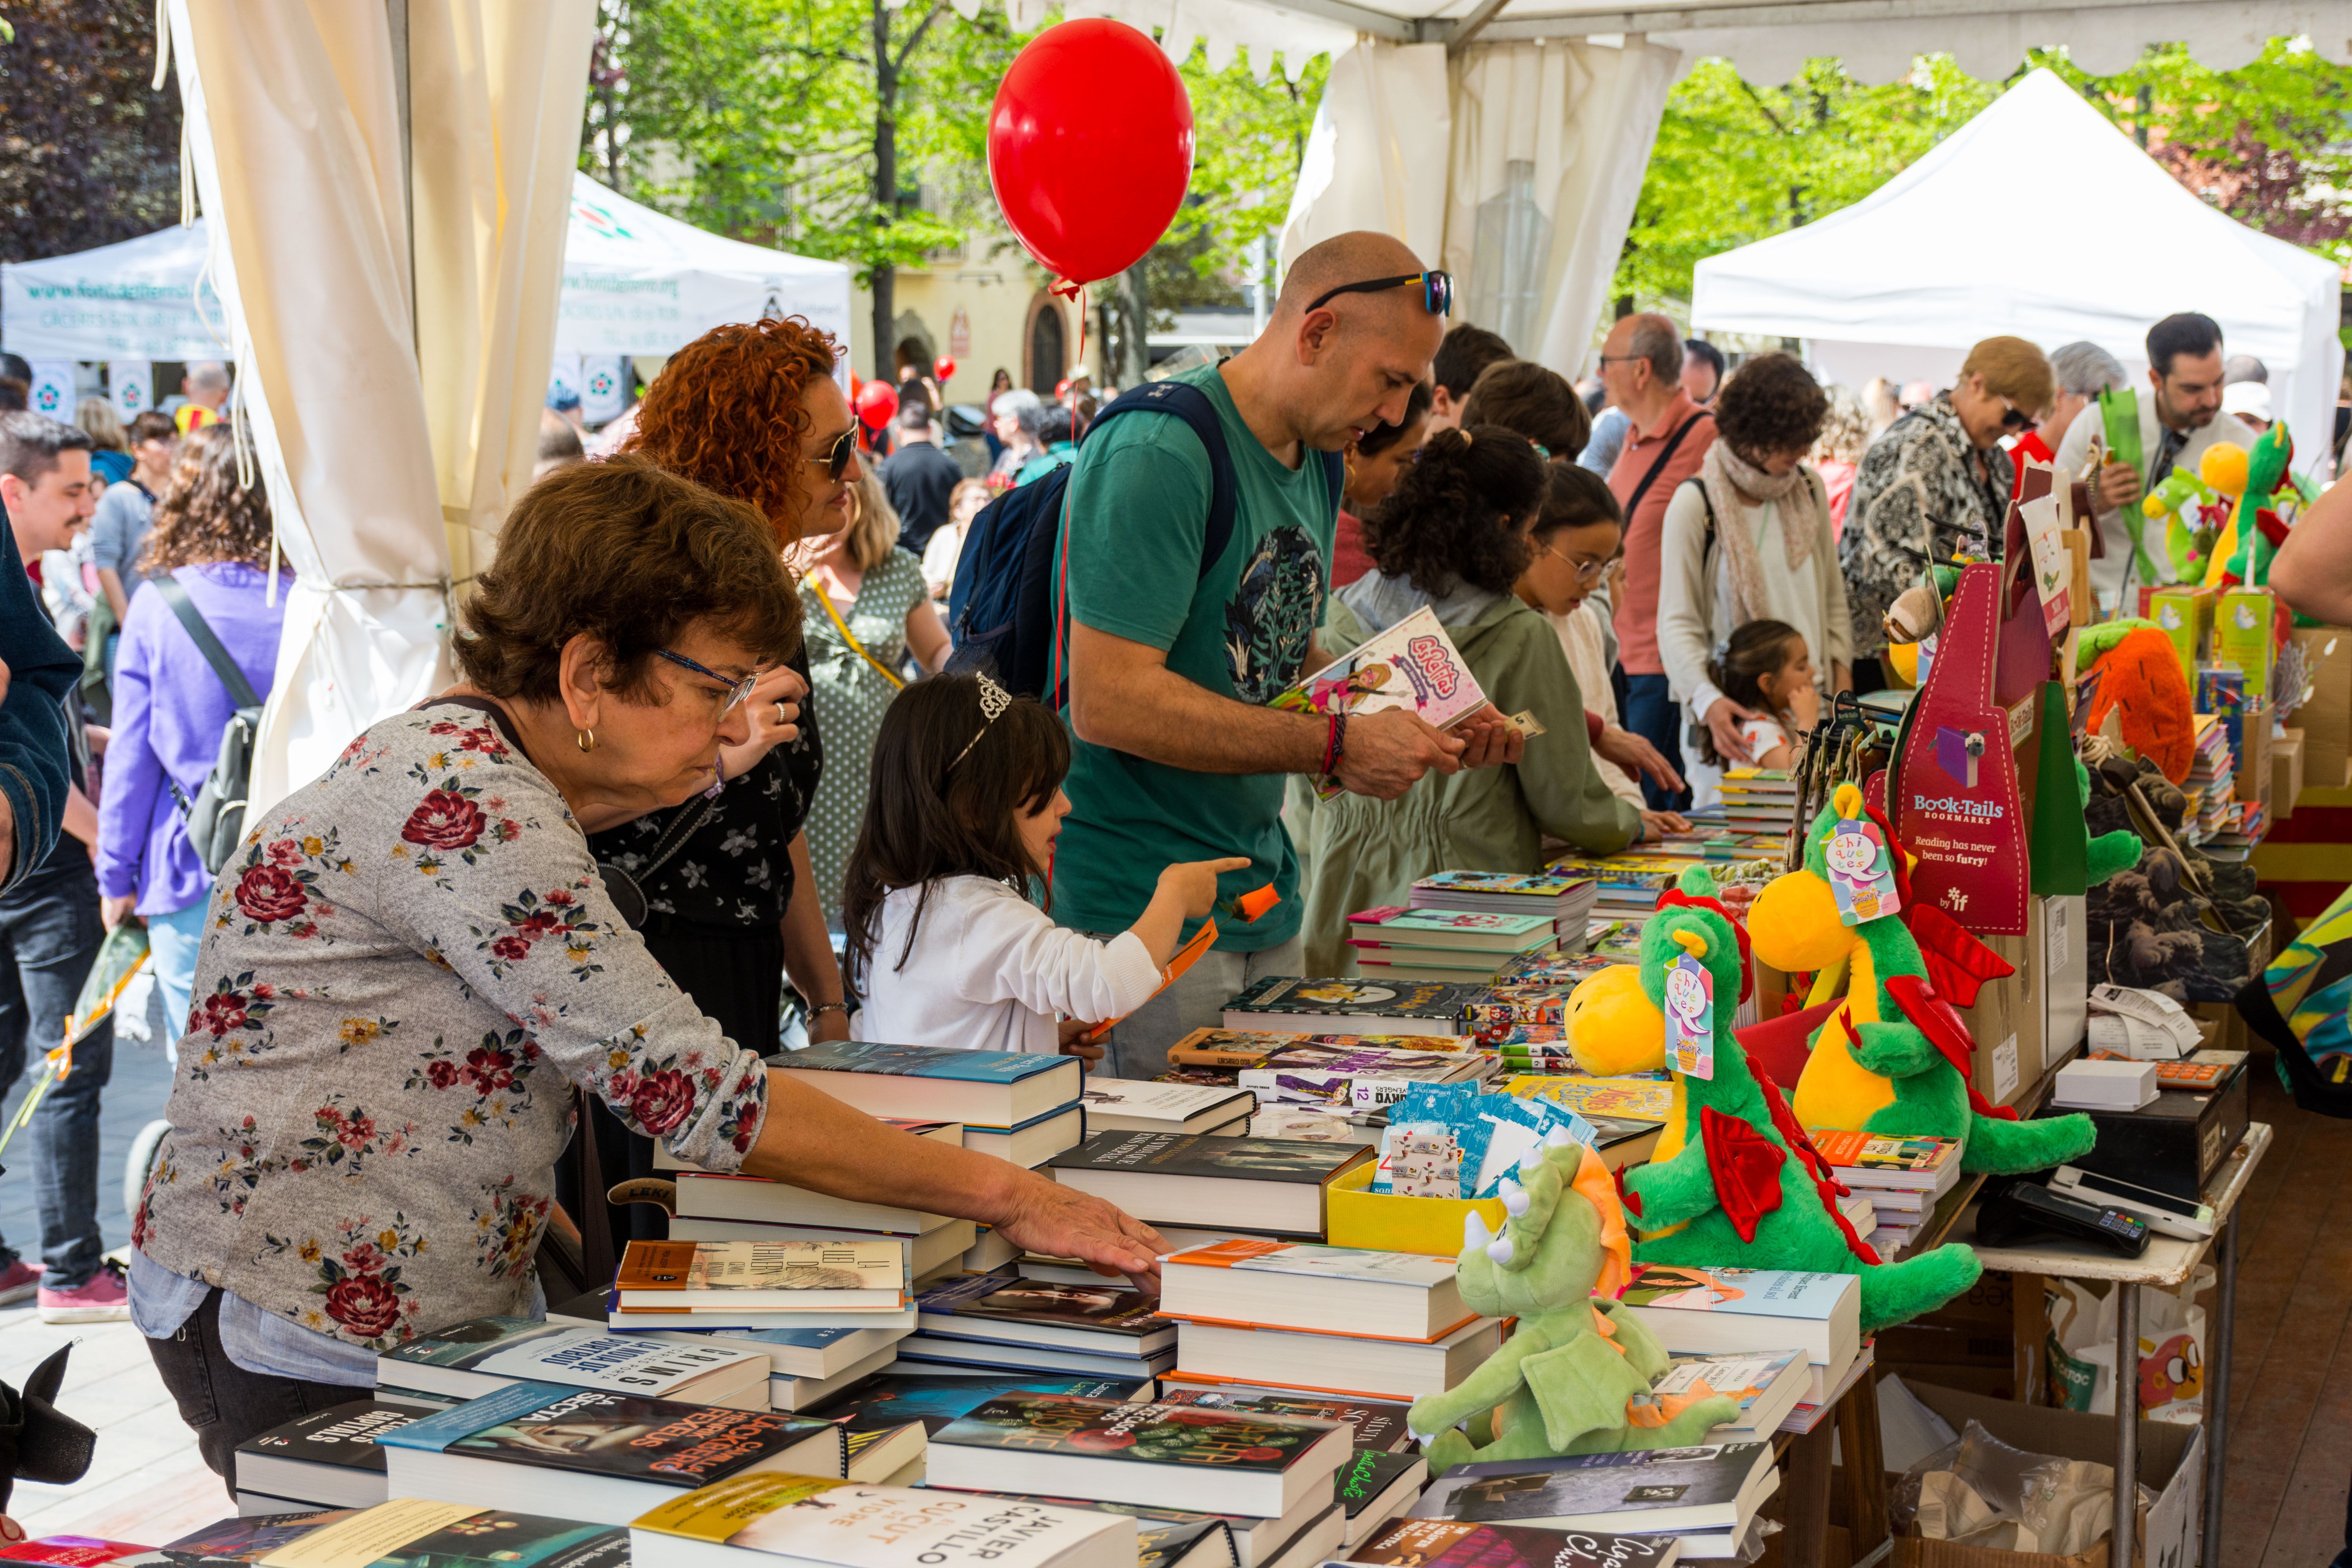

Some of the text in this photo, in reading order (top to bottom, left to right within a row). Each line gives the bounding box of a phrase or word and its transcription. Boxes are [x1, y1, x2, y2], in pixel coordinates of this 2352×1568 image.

[1412, 639, 1456, 694] Las Ratitas
[1515, 716, 1524, 725] 5
[1914, 795, 2004, 818] Book-Tails
[1924, 812, 1991, 825] BOOKMARKS
[1915, 836, 1996, 853] Reading has never
[1922, 850, 1987, 867] been so furry!
[1940, 897, 1950, 908] by
[1490, 1008, 1501, 1018] 19
[1357, 1087, 1368, 1101] 12
[1127, 1132, 1157, 1143] ENS
[1091, 1143, 1139, 1163] SEPARA
[1134, 1141, 1169, 1154] VIDA
[1116, 1154, 1147, 1165] QUE
[786, 1261, 819, 1271] DE
[858, 1261, 890, 1269] LA
[1763, 1291, 1778, 1299] sol
[1787, 1285, 1808, 1299] Sirvent
[540, 1338, 632, 1366] PORTBOU
[567, 1341, 670, 1373] LA NOIA DE
[638, 1349, 683, 1363] CARLES
[597, 1364, 639, 1380] PORTA
[519, 1392, 606, 1421] SECTA
[595, 1396, 626, 1405] LA
[306, 1411, 404, 1443] CAPITALS
[629, 1407, 756, 1447] HENRIK FEXEUS
[1103, 1416, 1145, 1436] CASOS
[1354, 1416, 1392, 1441] SÍLVIA
[649, 1415, 791, 1471] LÄCKBERG
[679, 1441, 764, 1472] CAMILLA
[829, 1498, 905, 1528] VIDRE
[867, 1502, 966, 1544] CUCUT
[917, 1506, 1063, 1564] JAVIER CASTILLO
[1373, 1521, 1427, 1549] BIBLIOTECA
[1414, 1525, 1455, 1548] CADÁVER
